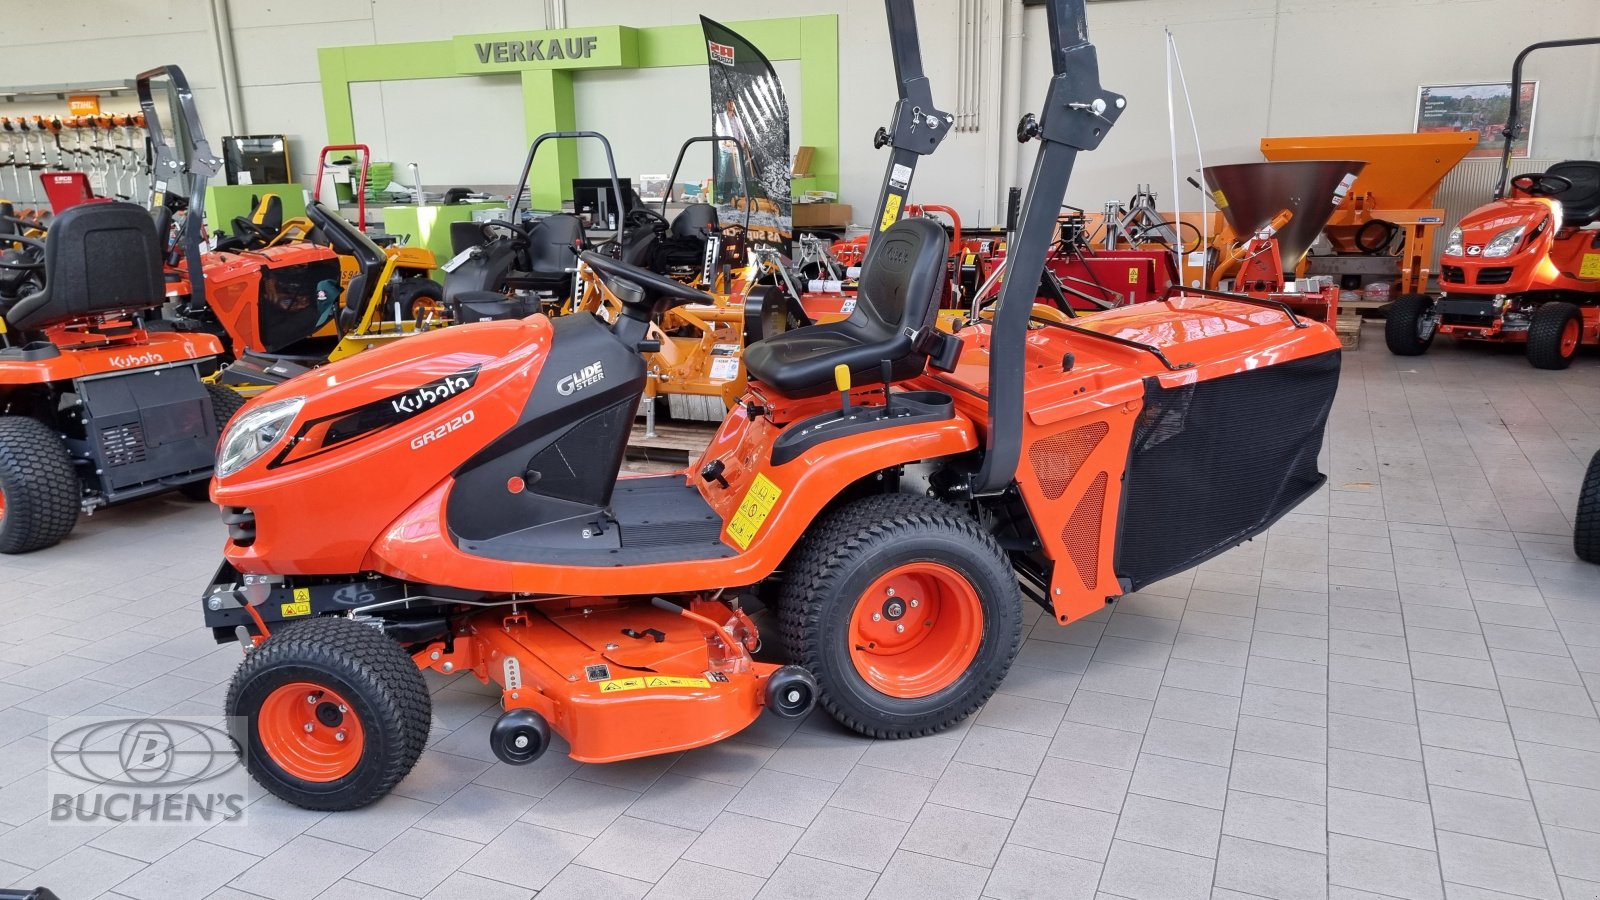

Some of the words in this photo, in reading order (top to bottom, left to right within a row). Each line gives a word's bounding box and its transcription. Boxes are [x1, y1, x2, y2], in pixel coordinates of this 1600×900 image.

[474, 36, 597, 64] VERKAUF
[71, 101, 94, 110] STIHL
[109, 352, 164, 368] Kubota
[556, 360, 603, 396] GLIDE
[575, 372, 605, 391] STEER
[391, 377, 470, 413] Kubota
[410, 409, 475, 450] GR2120
